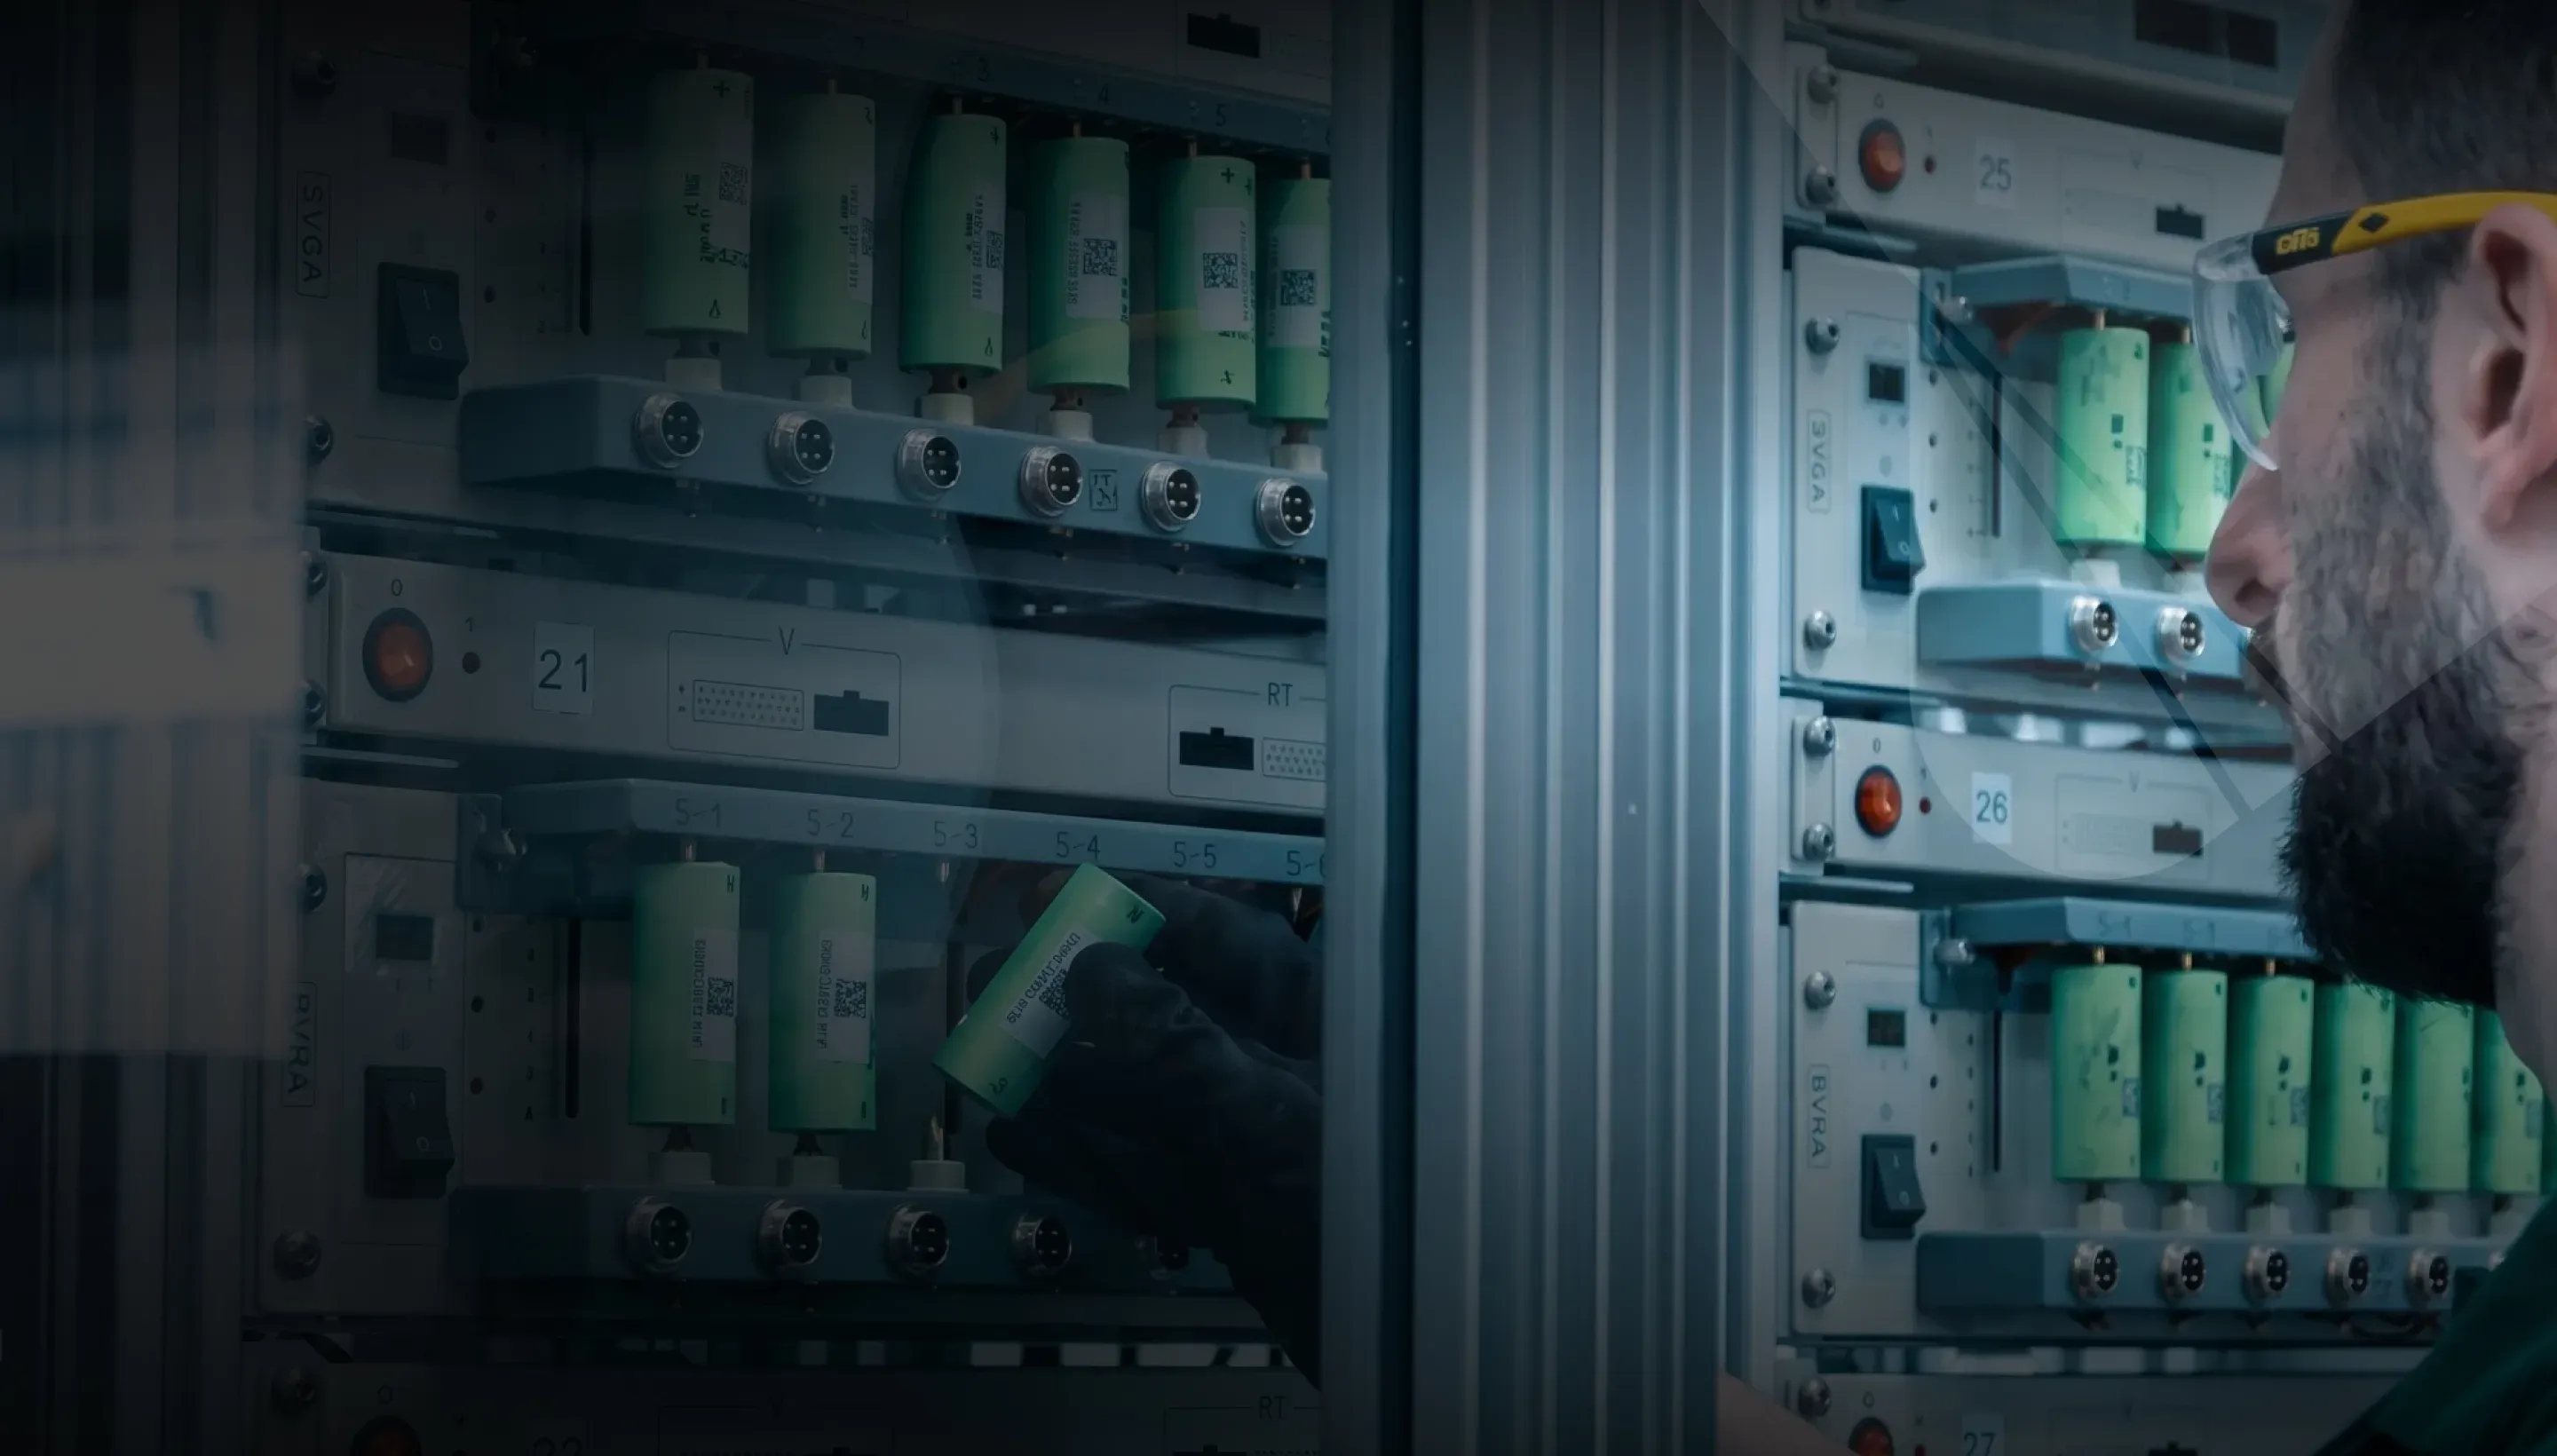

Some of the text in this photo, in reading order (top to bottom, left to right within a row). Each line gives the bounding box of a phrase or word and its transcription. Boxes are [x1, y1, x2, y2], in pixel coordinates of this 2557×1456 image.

[1980, 154, 2012, 192] 25
[303, 184, 324, 282] SVGA
[779, 625, 796, 656] V
[538, 648, 589, 692] 21
[1267, 681, 1294, 708] RT
[1976, 789, 2008, 824] 26
[1812, 1075, 1827, 1158] BVRA
[1258, 1395, 1287, 1420] RT
[1963, 1431, 1997, 1456] 27
